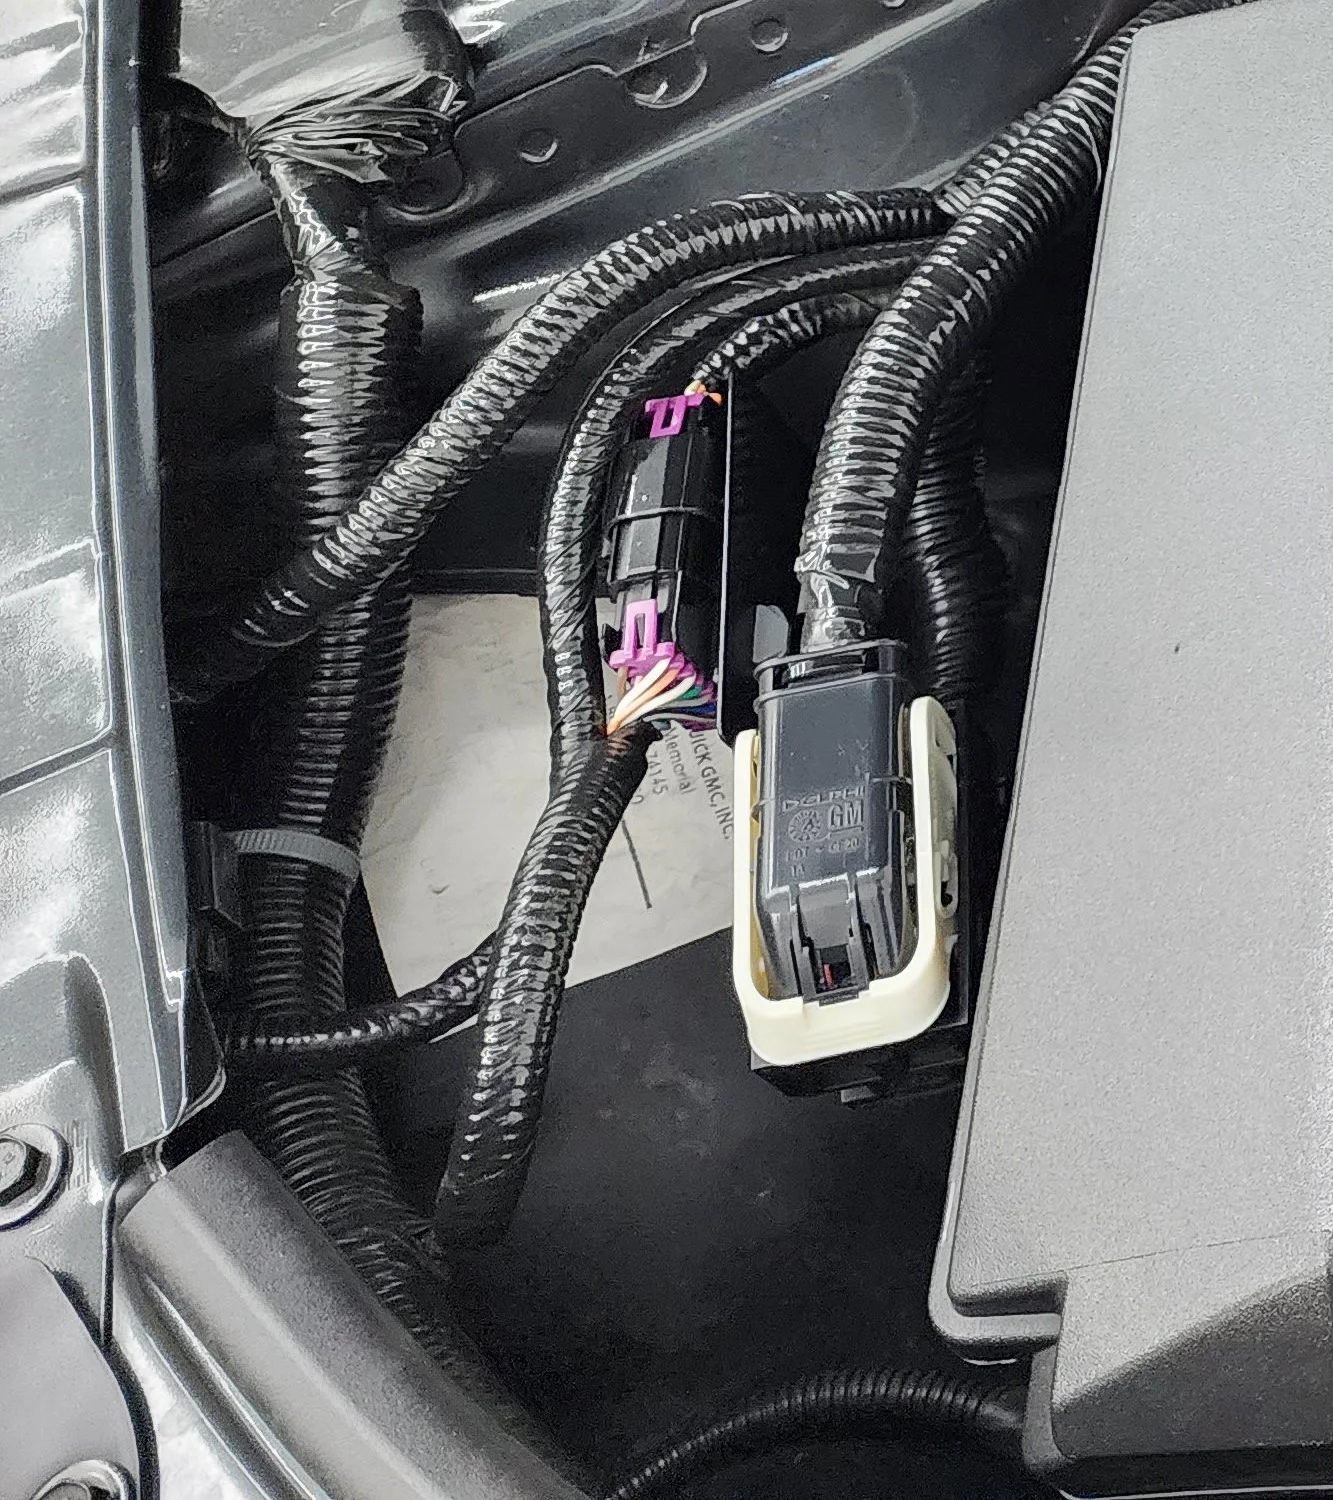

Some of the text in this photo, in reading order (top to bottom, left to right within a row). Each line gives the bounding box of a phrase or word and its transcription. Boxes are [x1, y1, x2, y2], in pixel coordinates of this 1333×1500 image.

[663, 726, 697, 795] Memorial
[689, 730, 712, 765] UICK
[828, 799, 865, 832] GM
